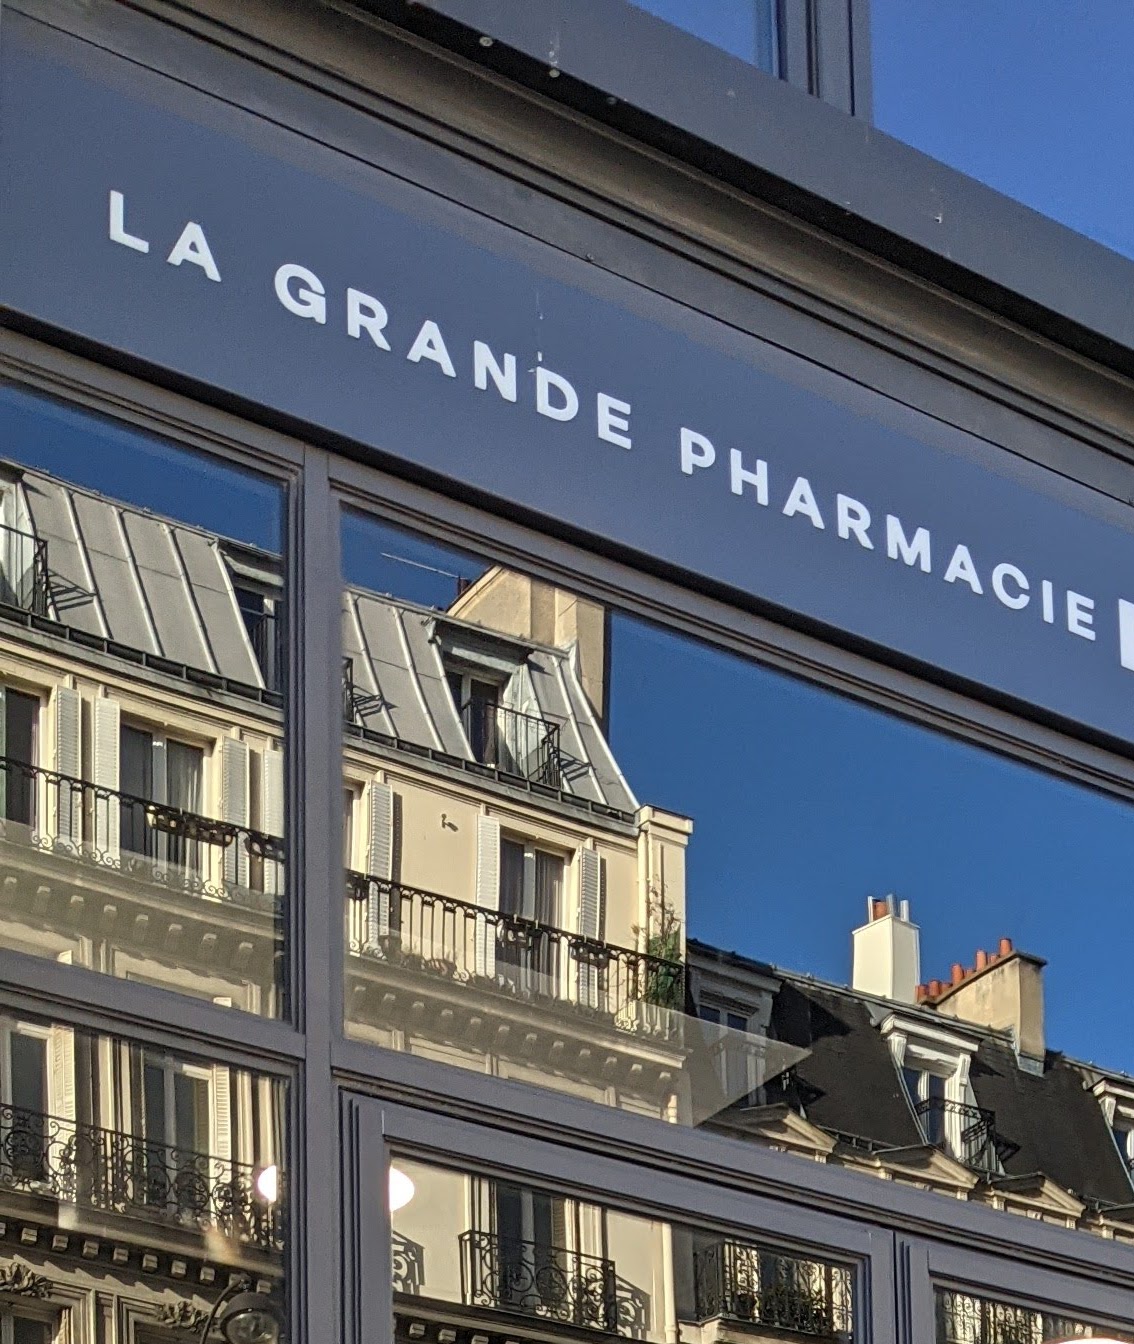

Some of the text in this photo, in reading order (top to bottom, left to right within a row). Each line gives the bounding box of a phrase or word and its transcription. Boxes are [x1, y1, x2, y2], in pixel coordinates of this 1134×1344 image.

[109, 189, 221, 283] LA
[273, 262, 633, 449] GRANDE
[679, 426, 1096, 642] PHARMACIE
